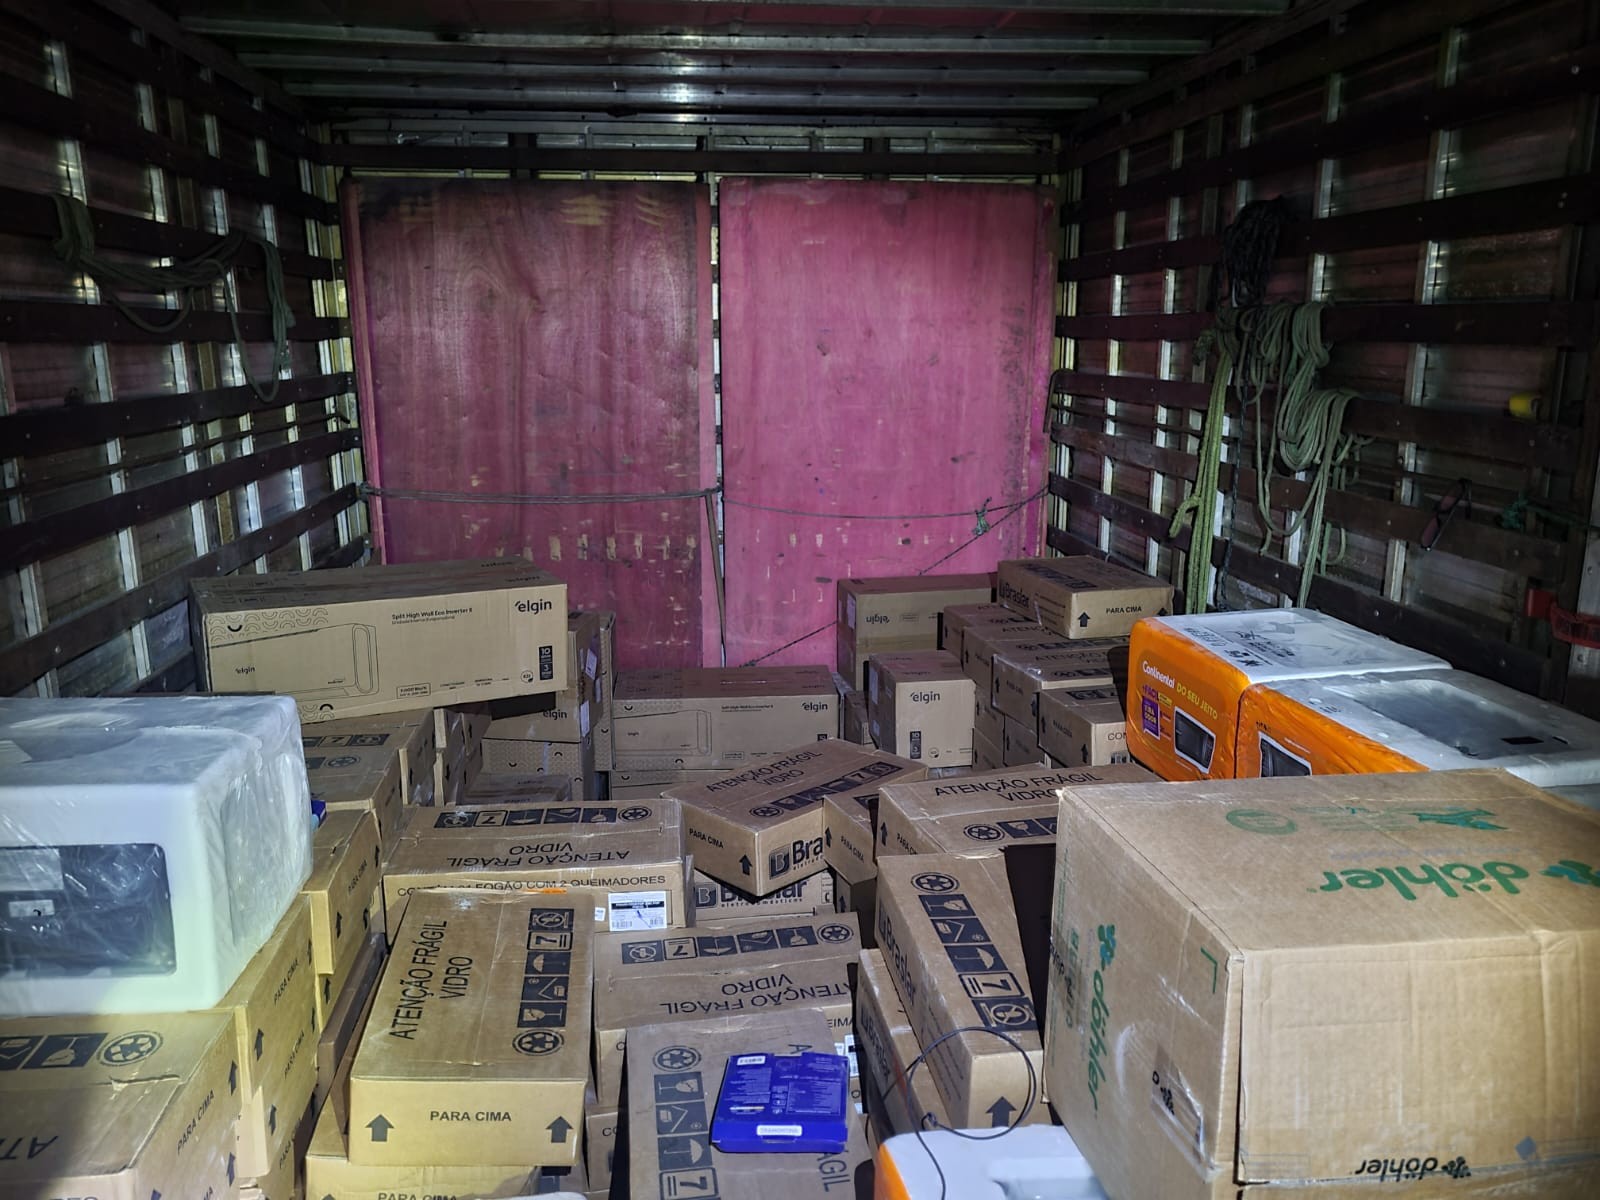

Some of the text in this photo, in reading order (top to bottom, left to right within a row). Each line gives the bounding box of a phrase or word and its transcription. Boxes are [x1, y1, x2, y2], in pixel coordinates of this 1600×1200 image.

[516, 599, 552, 615] elgin
[1126, 605, 1142, 613] CIMA
[910, 690, 941, 704] elgin
[1143, 660, 1175, 688] Continental
[1177, 682, 1187, 696] DO
[1188, 690, 1200, 705] SEU
[1200, 700, 1218, 720] JEITO
[543, 709, 567, 720] elgin
[802, 702, 828, 712] elgin
[706, 751, 822, 792] ATENÇÃO FRÁGIL
[757, 769, 804, 786] VIDRO
[935, 772, 1103, 796] ATENÇÃO FRÁGIL
[998, 789, 1057, 801] VIDRO
[689, 828, 724, 848] PARA CIMA
[509, 842, 573, 856] VIDRO
[793, 838, 824, 865] Bra
[446, 850, 630, 868] ATENÇÃO FRÁGIL
[527, 880, 556, 889] COM
[560, 880, 567, 888] 2
[570, 875, 666, 887] QUEIMADORES
[1319, 861, 1530, 902] döhler
[389, 920, 448, 1040] ATENÇÃO FRÁGIL
[439, 956, 473, 1000] VIDRO
[722, 974, 793, 996] VIDRO
[660, 998, 744, 1014] FRÁGIL
[1088, 970, 1110, 1110] döhler
[178, 1090, 215, 1156] PARA CIMA
[430, 1110, 512, 1122] PARA CIMA
[0, 1135, 59, 1160] AT
[1355, 1157, 1438, 1182] döhler
[378, 1192, 417, 1200] PARA
